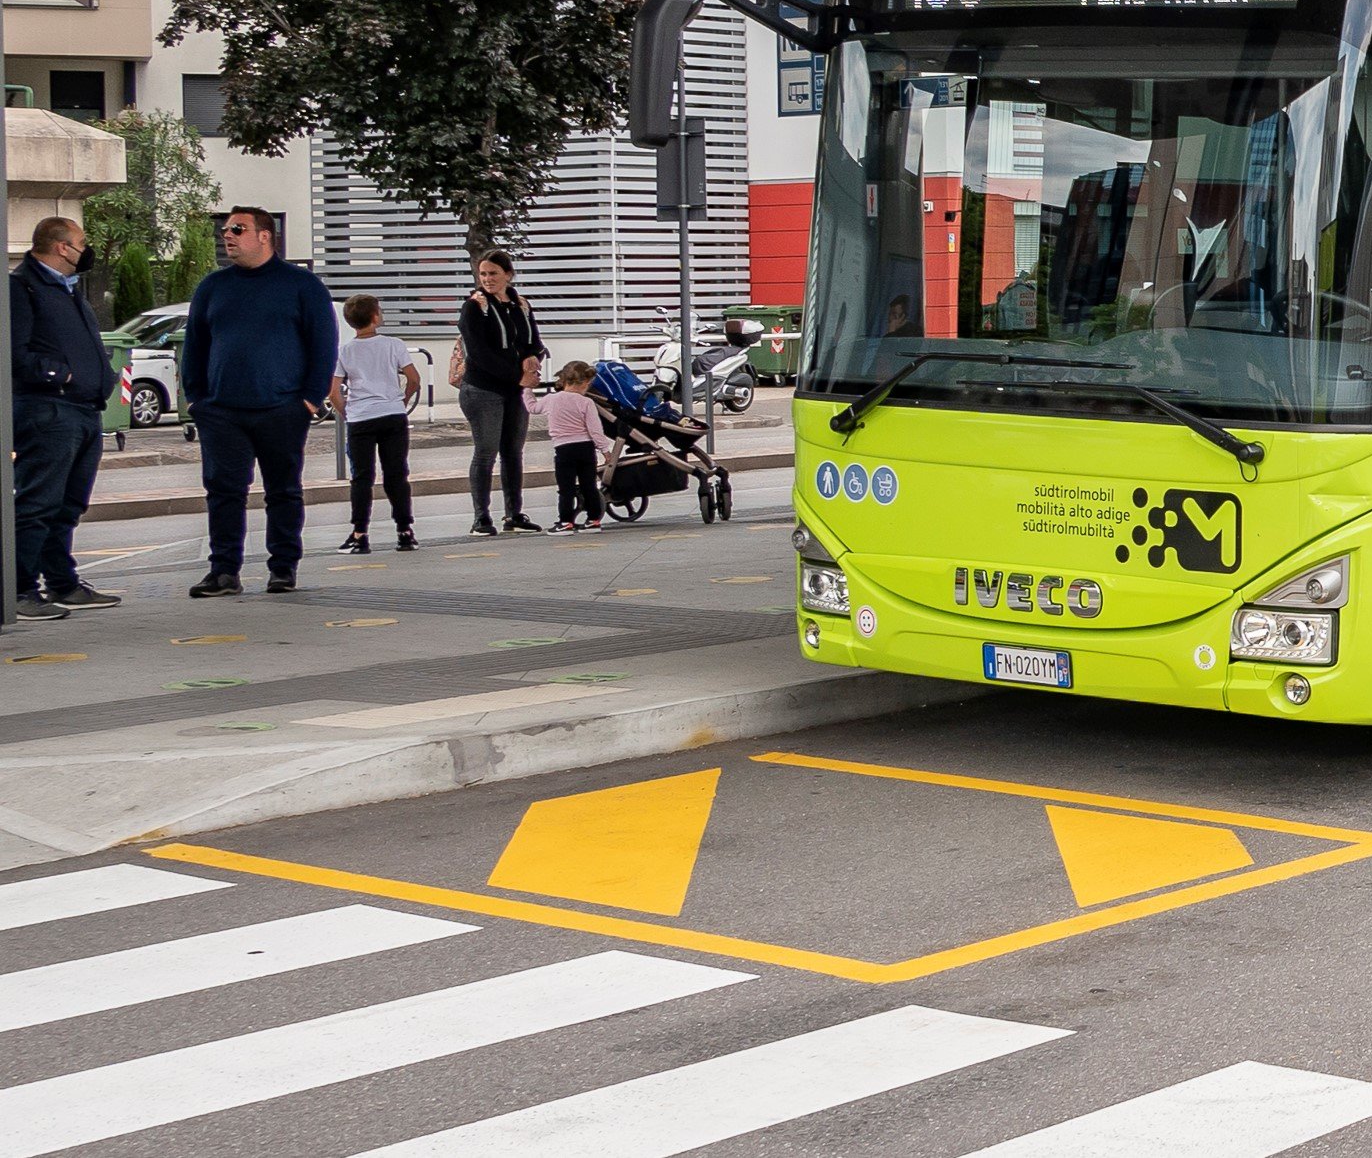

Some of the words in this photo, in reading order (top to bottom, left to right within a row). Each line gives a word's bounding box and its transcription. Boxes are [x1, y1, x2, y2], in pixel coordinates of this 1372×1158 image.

[1034, 485, 1114, 502] südtirolmobil
[1017, 501, 1065, 517] mobilità
[1069, 504, 1093, 519] alto
[1096, 506, 1131, 524] adige
[1022, 519, 1115, 538] südtirolmubiltà
[953, 567, 1103, 619] IVECO
